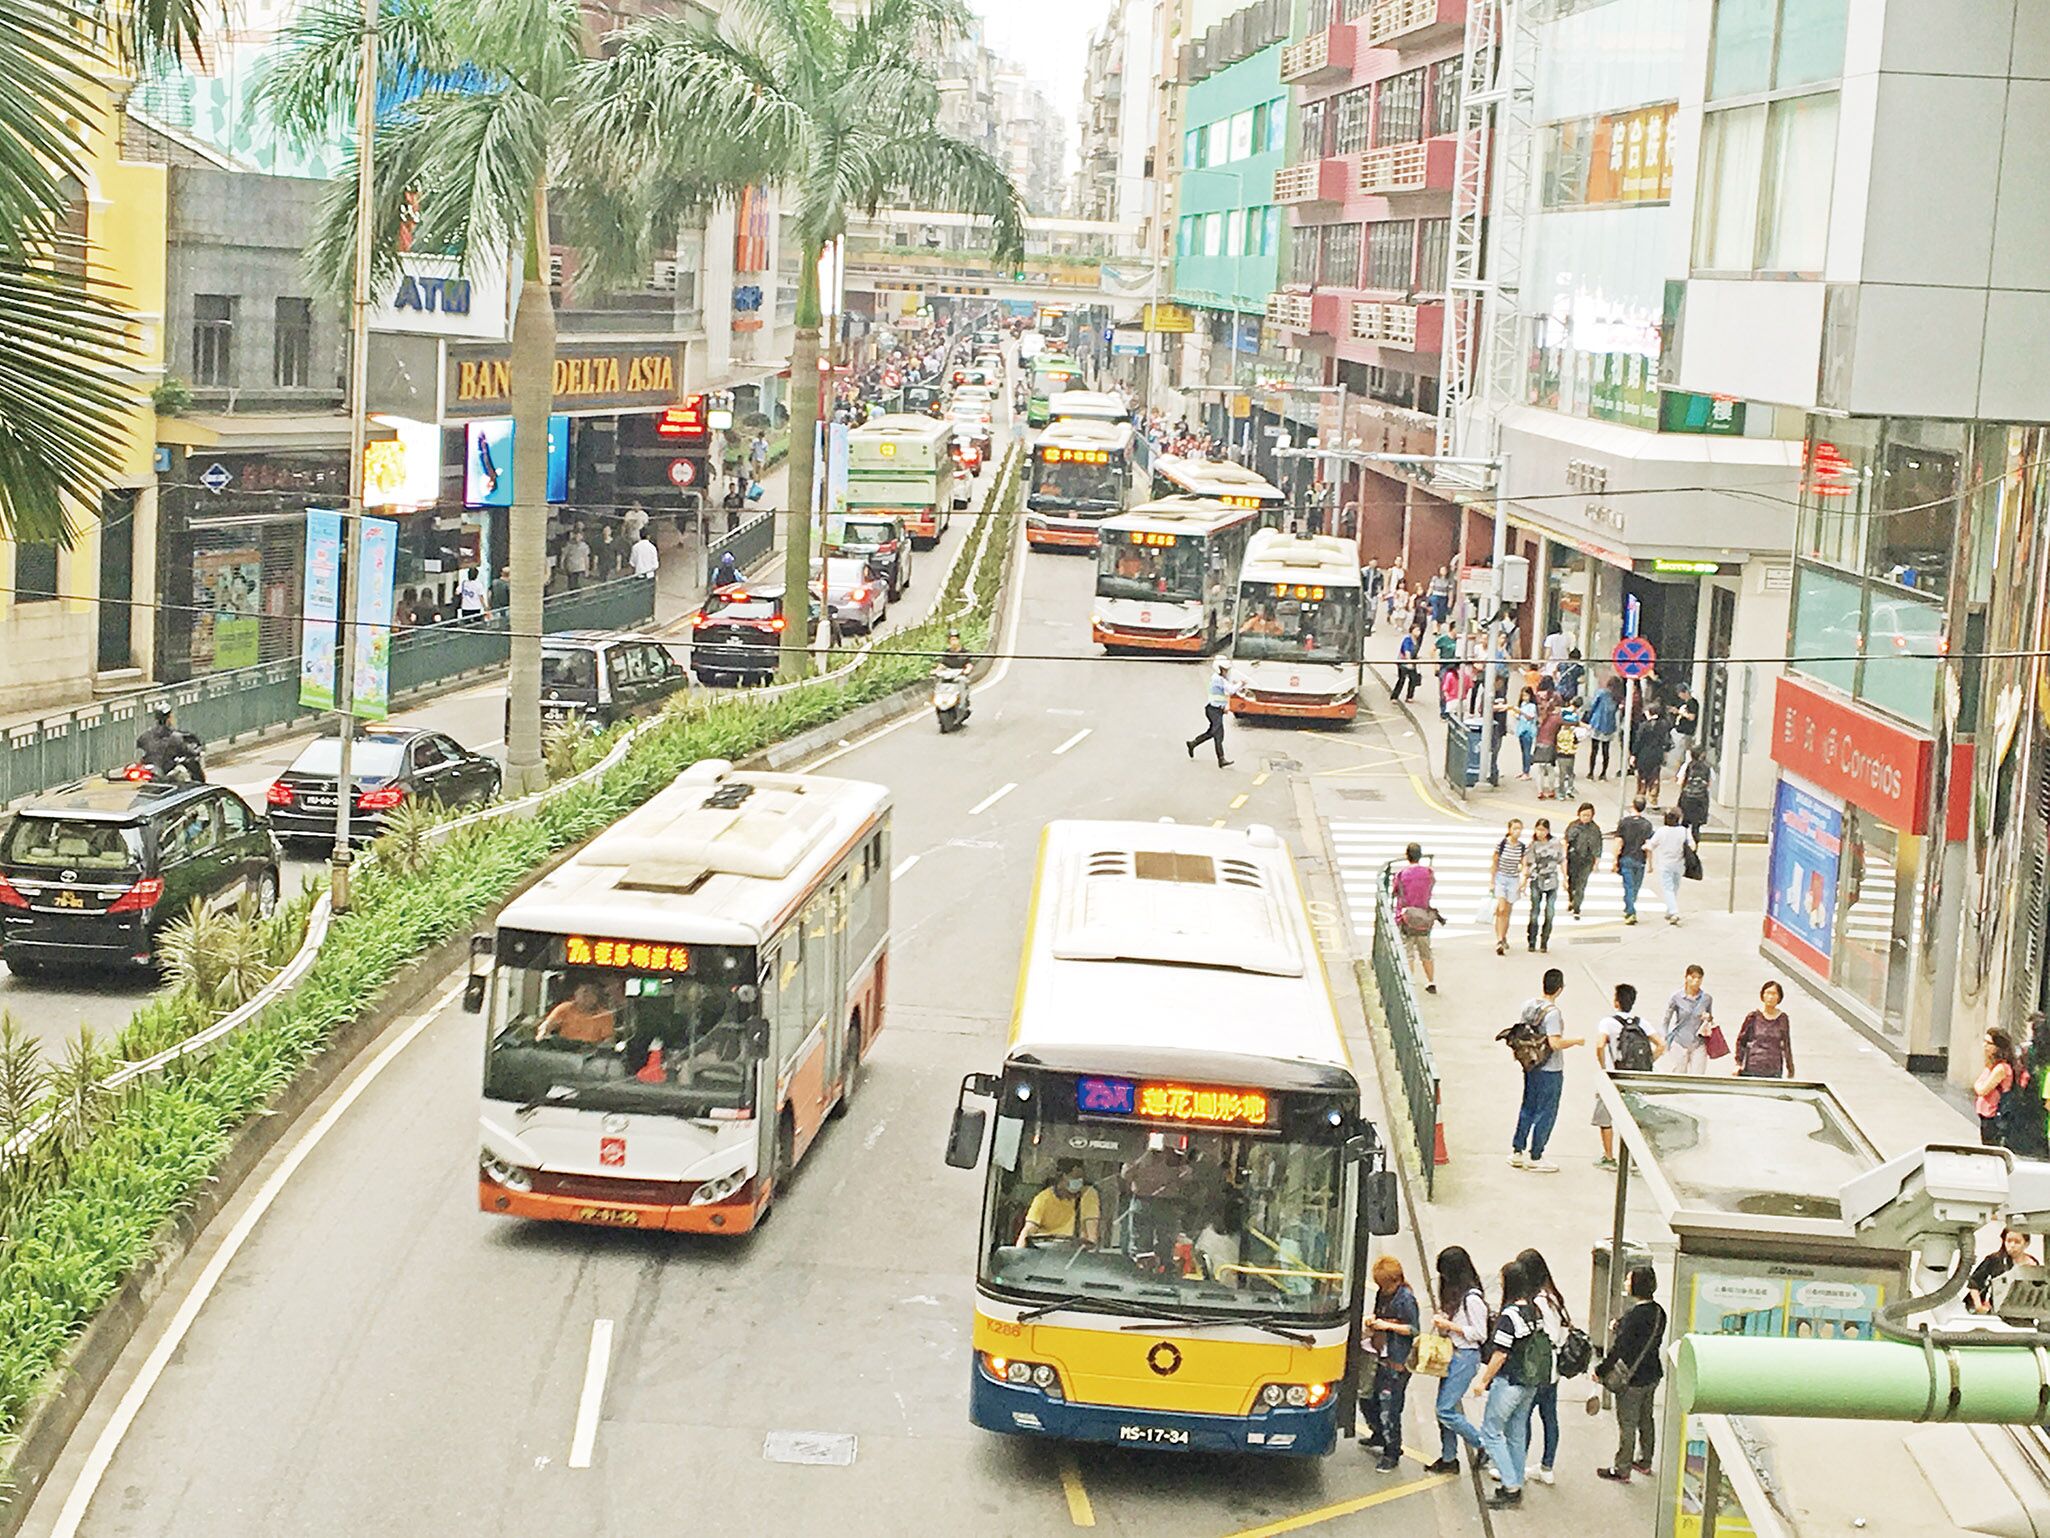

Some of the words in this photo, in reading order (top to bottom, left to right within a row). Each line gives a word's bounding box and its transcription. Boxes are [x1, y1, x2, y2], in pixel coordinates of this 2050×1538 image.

[394, 275, 471, 315] ATM
[459, 361, 513, 400] BAN
[553, 357, 620, 395] DELTA
[627, 356, 673, 391] ASIA
[1840, 734, 1902, 800] Correios
[1119, 1426, 1189, 1445] MS-17-34
